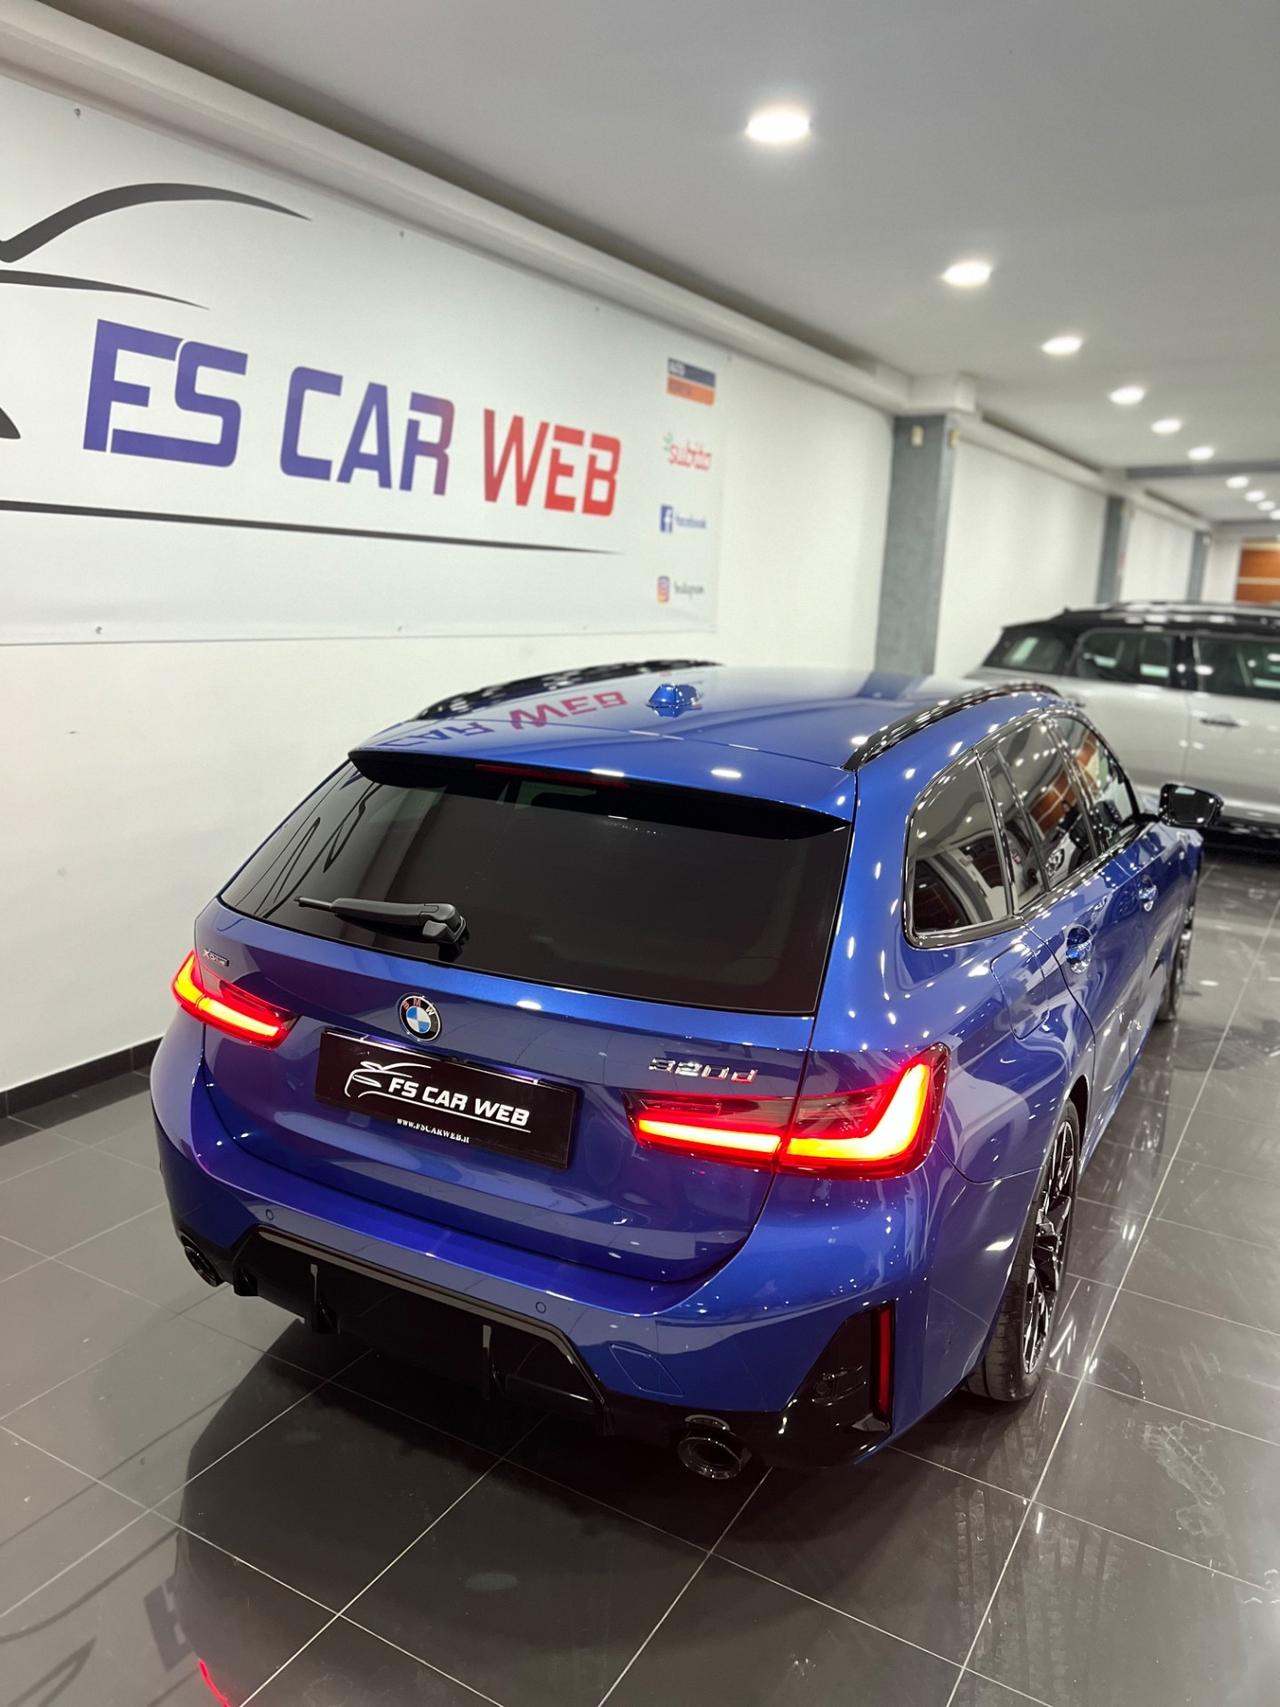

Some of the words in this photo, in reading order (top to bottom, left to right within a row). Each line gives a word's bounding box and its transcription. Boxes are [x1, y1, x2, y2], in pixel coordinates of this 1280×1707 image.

[83, 318, 249, 468] FS
[280, 366, 455, 496] CAR
[481, 408, 622, 517] WEB
[402, 997, 436, 1016] BMW
[648, 1057, 758, 1084] 320d
[388, 1077, 419, 1099] FS
[422, 1085, 469, 1112] CAR
[474, 1097, 530, 1127] WEB
